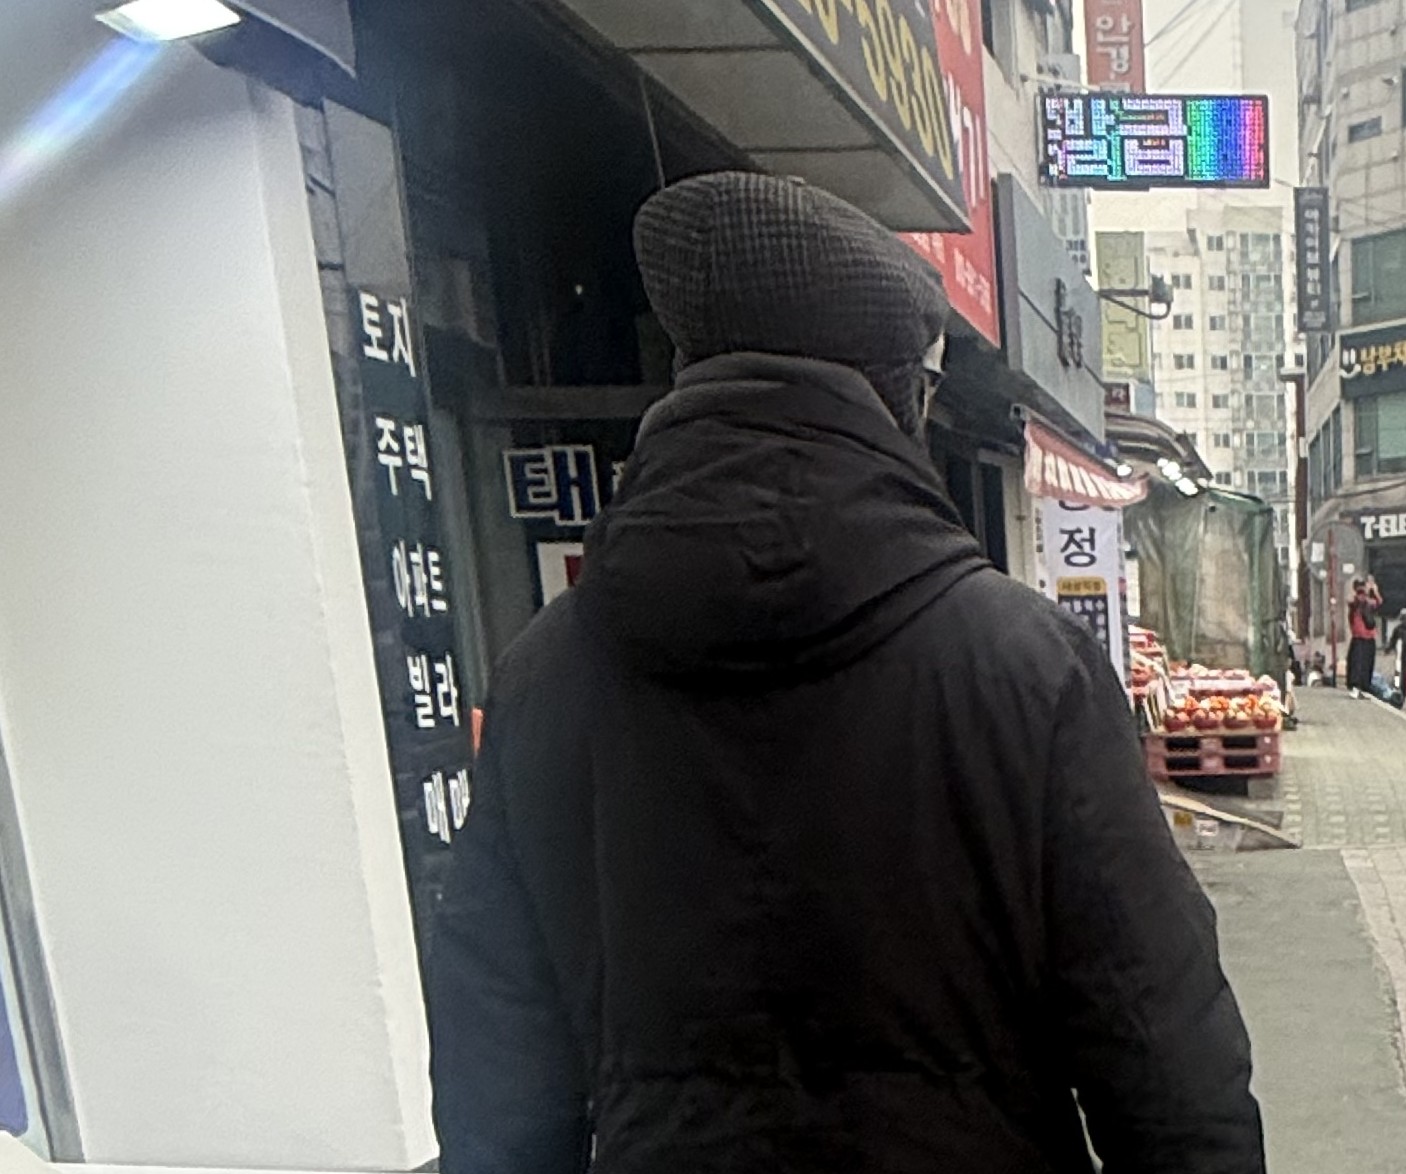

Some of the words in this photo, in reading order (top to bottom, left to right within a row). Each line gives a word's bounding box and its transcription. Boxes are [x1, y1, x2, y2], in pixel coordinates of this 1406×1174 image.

[359, 292, 416, 378] 토지
[374, 416, 432, 500] 주택
[503, 444, 626, 526] 태
[391, 539, 447, 618] 아파트
[406, 650, 460, 728] 빌라
